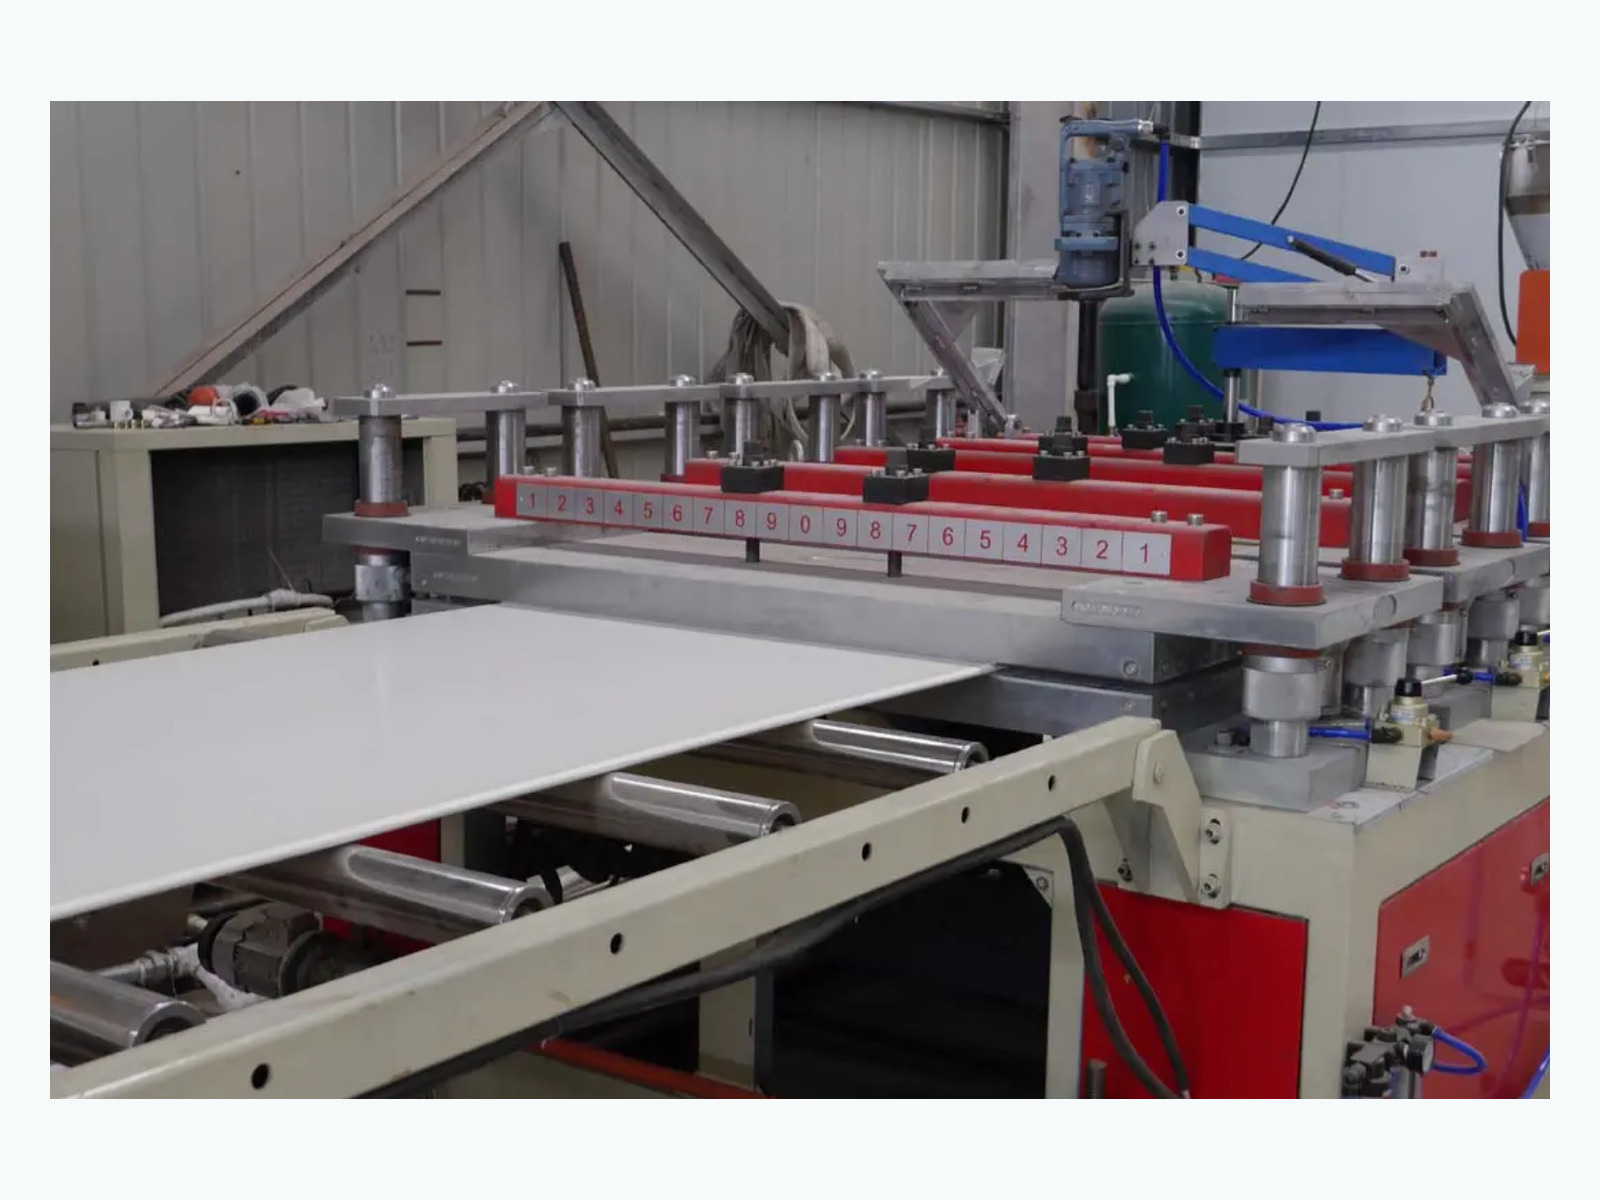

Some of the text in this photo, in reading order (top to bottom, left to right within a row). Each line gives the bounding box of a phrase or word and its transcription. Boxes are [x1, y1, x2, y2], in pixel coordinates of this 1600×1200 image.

[529, 493, 1149, 563] 1 2 3 4 5 6 7 8 9 0 9 8 7 6 5 4 3 2 1
